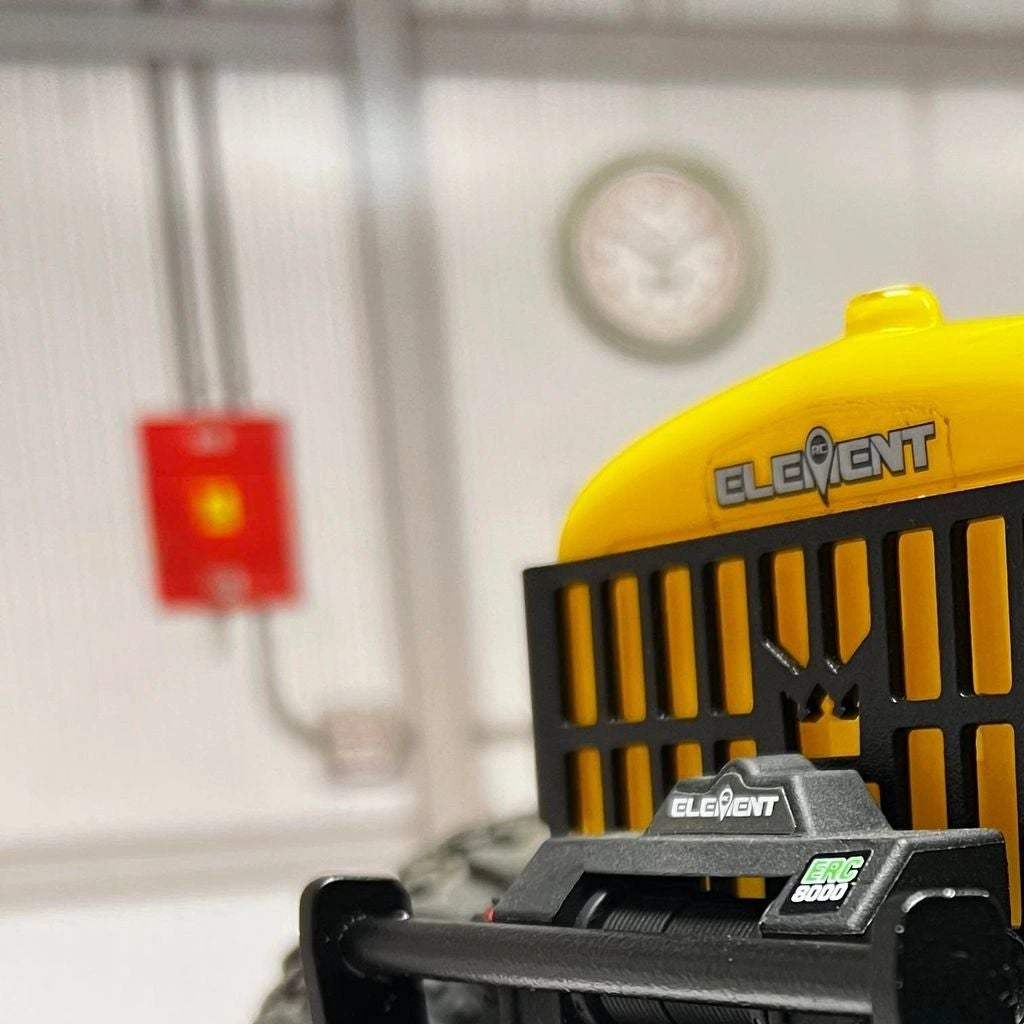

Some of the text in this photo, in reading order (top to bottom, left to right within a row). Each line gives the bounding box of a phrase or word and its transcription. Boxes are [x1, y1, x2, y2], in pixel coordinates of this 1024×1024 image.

[714, 421, 936, 509] ELEMENT
[671, 787, 780, 822] ELEMENT
[800, 856, 865, 884] ERC
[791, 882, 849, 902] 8000
